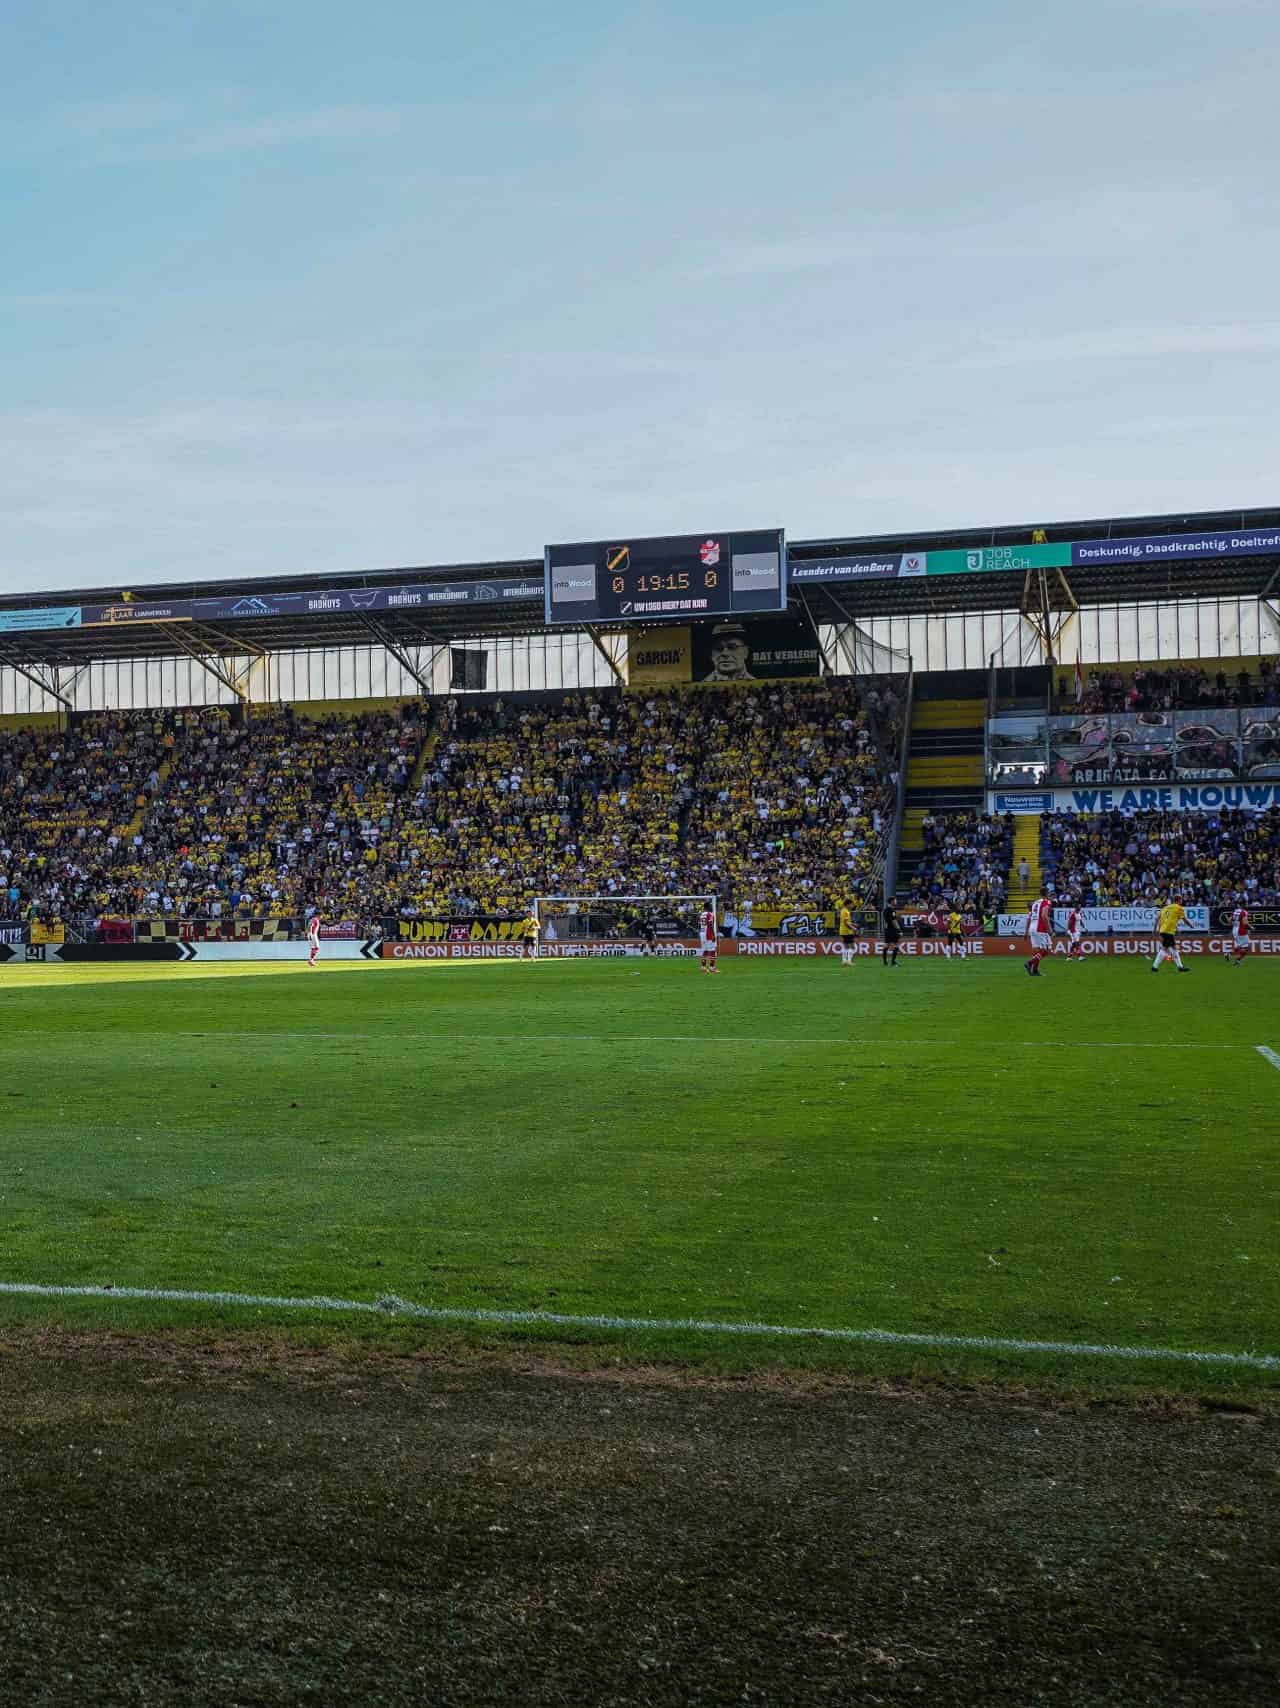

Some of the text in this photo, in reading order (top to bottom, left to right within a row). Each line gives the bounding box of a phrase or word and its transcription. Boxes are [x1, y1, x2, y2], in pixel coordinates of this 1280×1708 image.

[986, 548, 1012, 559] JOB
[1079, 545, 1143, 558] Deskundig.
[1145, 540, 1229, 553] Daadkrachtig.
[792, 562, 894, 577] Leendert van den Born
[985, 558, 1030, 570] REACH
[612, 570, 717, 593] 0 19:15 0
[634, 602, 645, 612] UW
[645, 601, 661, 611] LOGO
[680, 599, 691, 609] DAT
[637, 650, 680, 665] GARCIA
[1072, 790, 1113, 810] WE
[1120, 788, 1173, 809] ARE
[1000, 915, 1021, 928] sbr
[393, 945, 448, 957] CANON
[451, 945, 525, 957] BUSINESS
[738, 942, 817, 954] PRINTERS
[874, 942, 918, 954] EKE
[1051, 940, 1112, 953] AON
[1208, 940, 1280, 953] CETER
